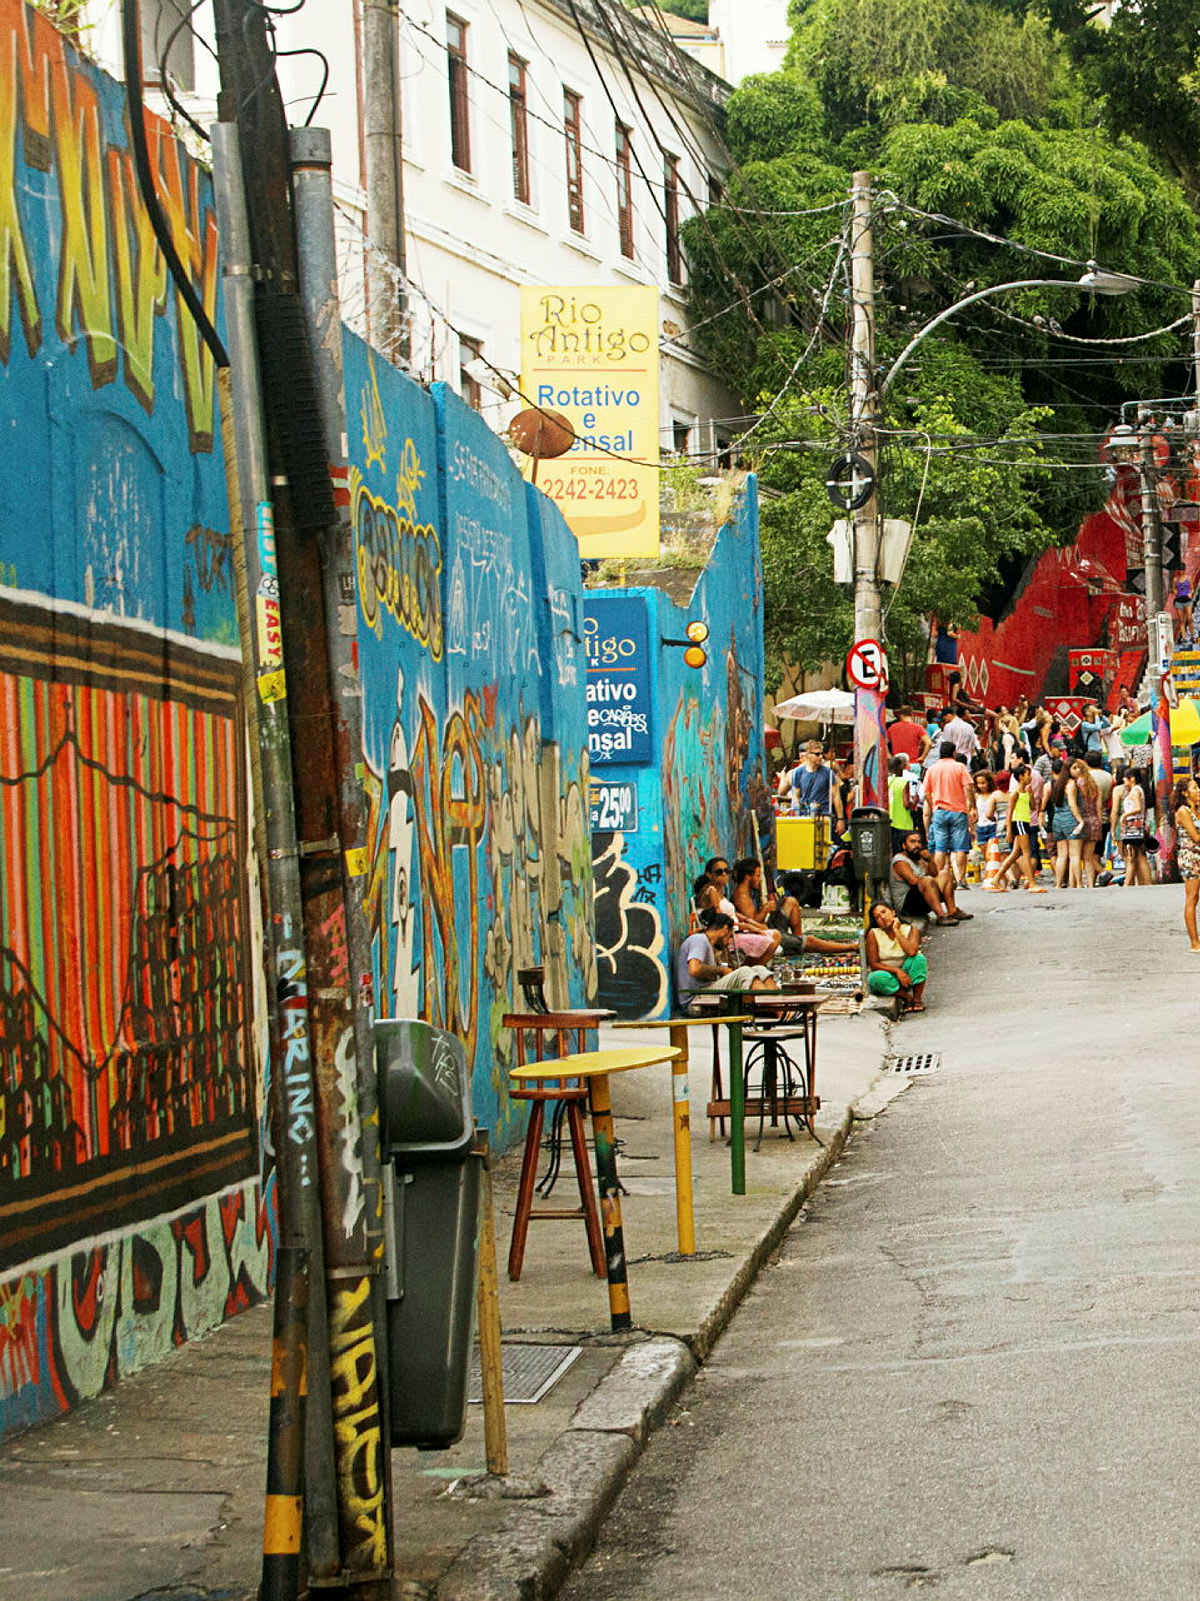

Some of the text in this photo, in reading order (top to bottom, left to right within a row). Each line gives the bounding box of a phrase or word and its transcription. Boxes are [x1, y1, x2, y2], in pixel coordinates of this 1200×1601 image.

[540, 294, 602, 329] Rio
[529, 325, 650, 361] Antigo
[546, 354, 602, 365] PARK
[538, 384, 641, 406] Rotativo
[583, 412, 597, 429] e
[570, 429, 633, 452] ensal
[543, 478, 639, 500] 2242-2423
[265, 600, 282, 659] EASY
[584, 635, 636, 664] tigo
[861, 649, 877, 678] E
[586, 678, 638, 703] ativo
[588, 708, 601, 727] e
[588, 727, 633, 752] nsal
